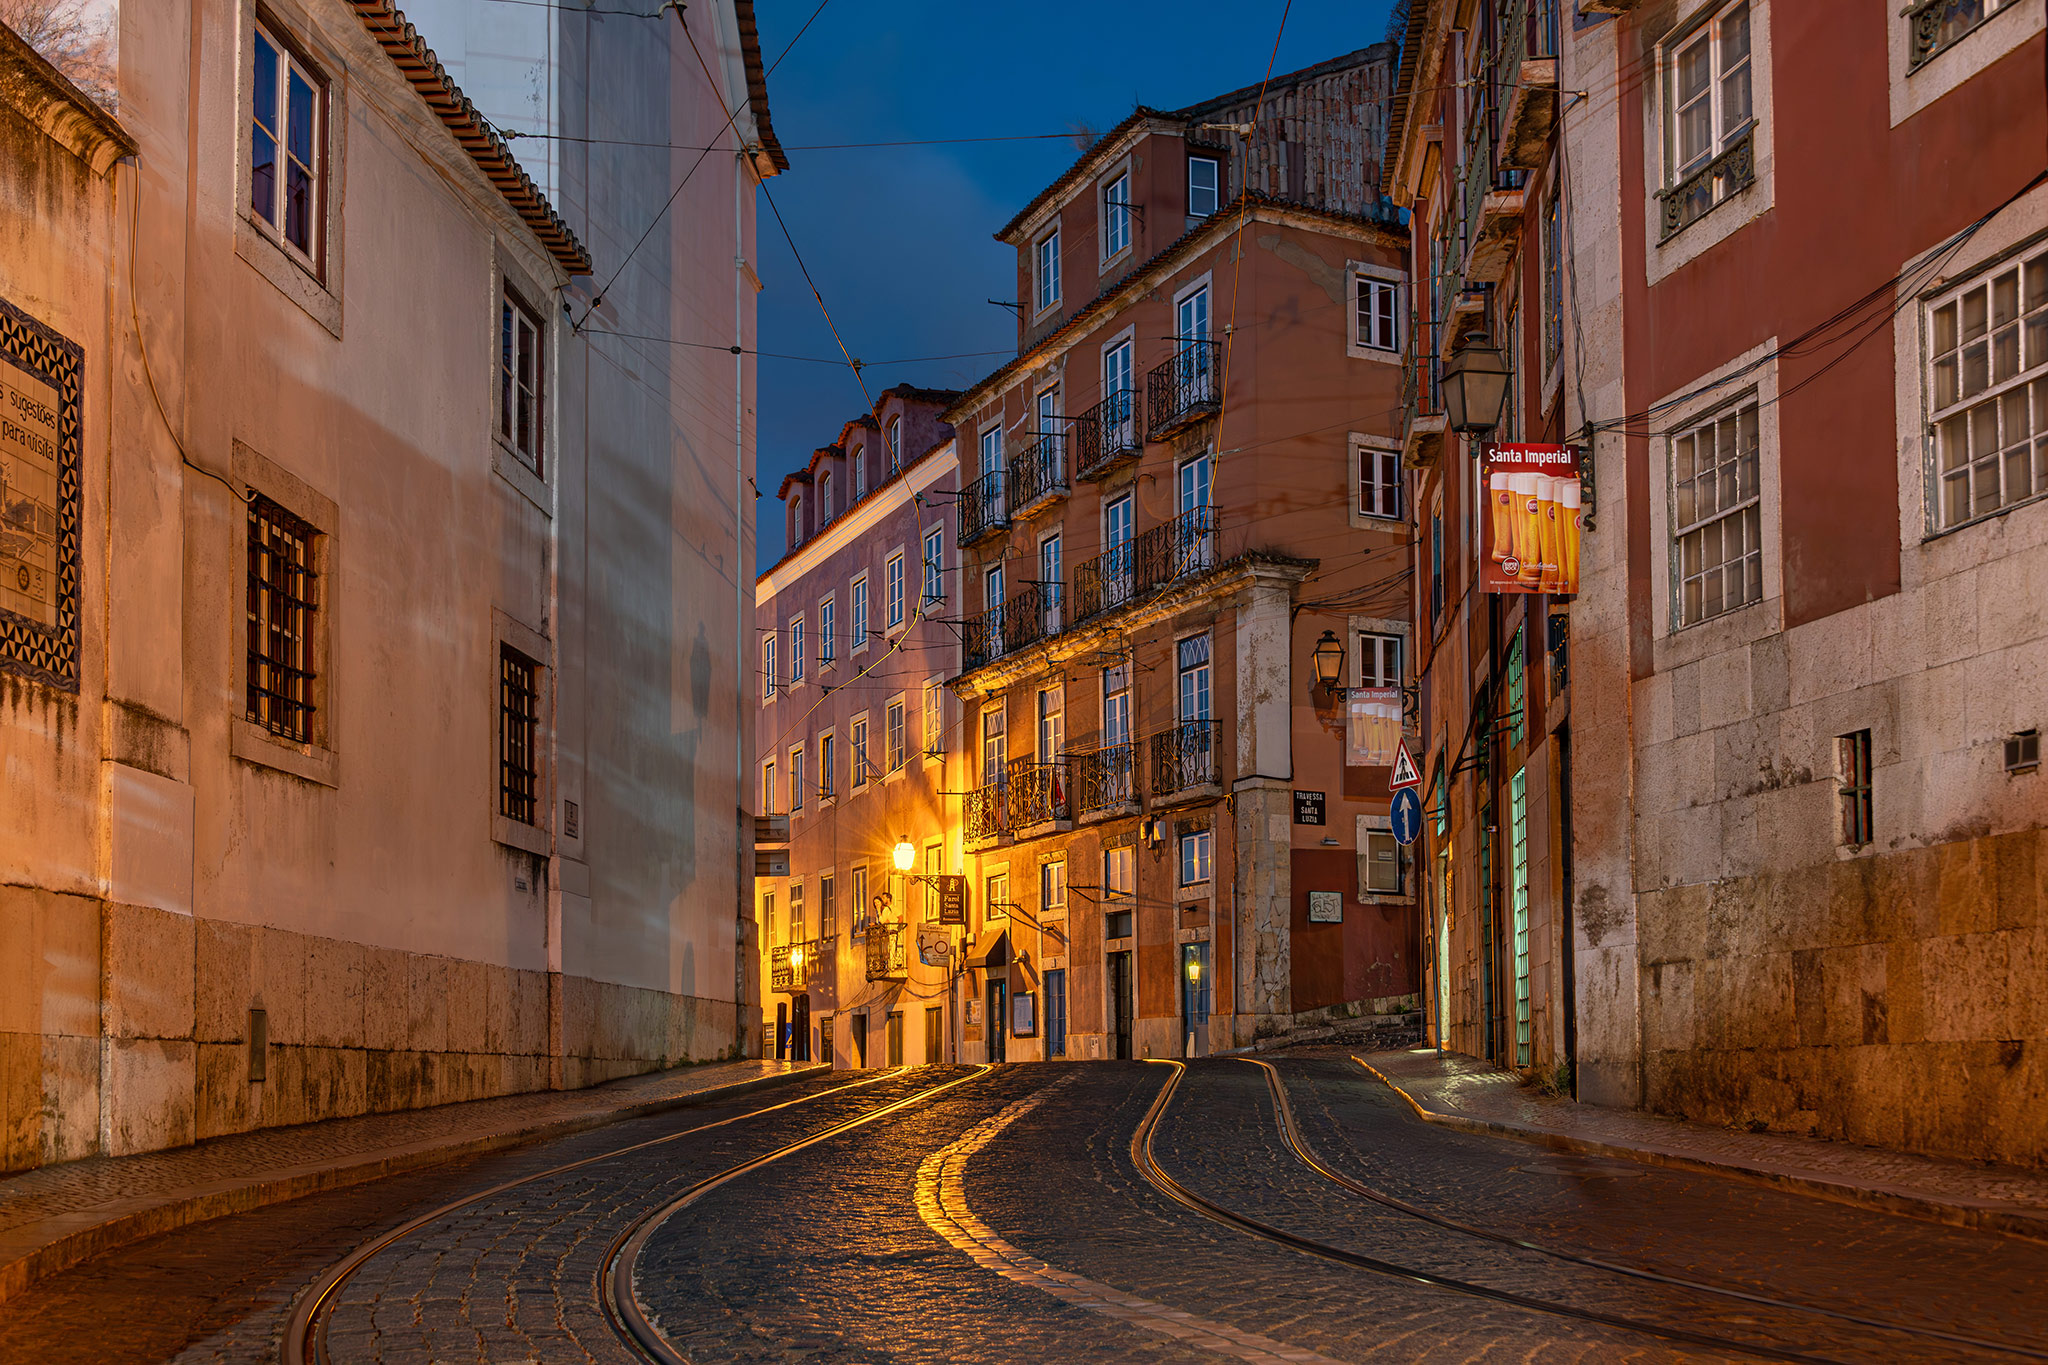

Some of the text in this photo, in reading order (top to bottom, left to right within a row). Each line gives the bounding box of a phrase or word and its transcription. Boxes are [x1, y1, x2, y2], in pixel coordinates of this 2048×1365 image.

[10, 391, 56, 429] sugestões
[2, 421, 54, 461] para visita
[1489, 448, 1571, 467] Santa Imperial
[1351, 690, 1398, 700] Santa Imperial
[1296, 792, 1323, 800] TRAVESSA
[1300, 806, 1318, 815] SANTA
[1302, 815, 1317, 823] LUZIA
